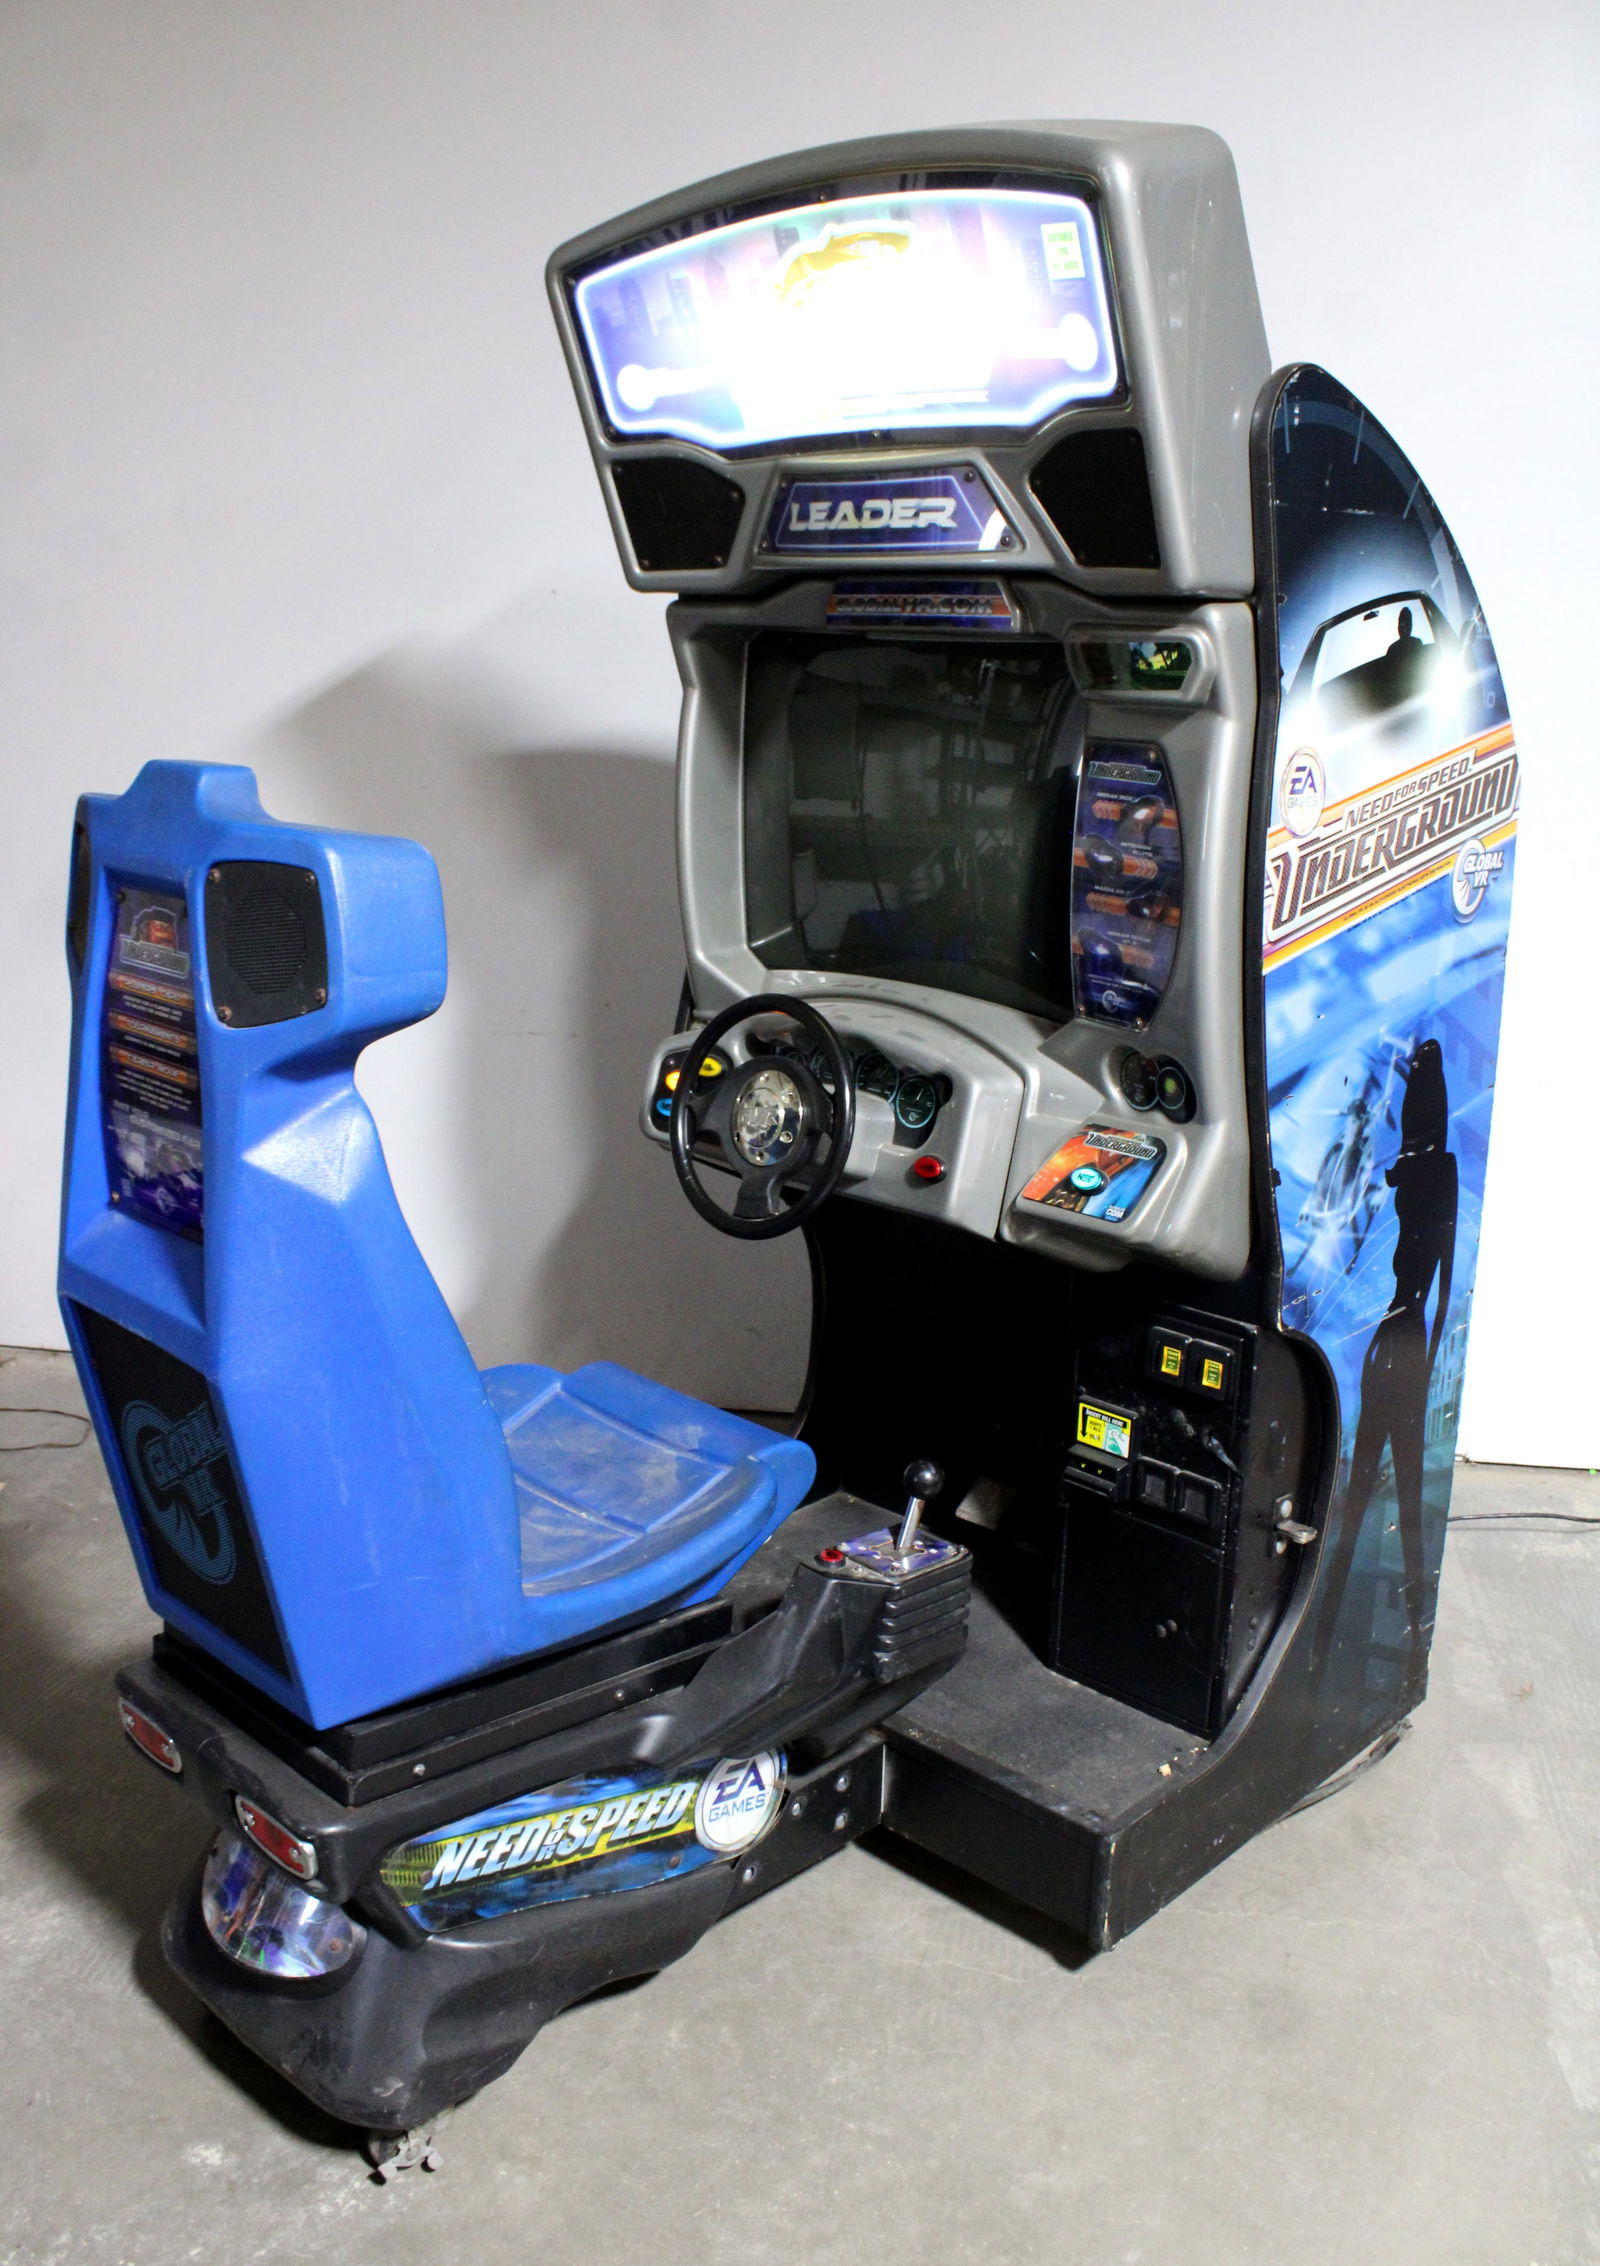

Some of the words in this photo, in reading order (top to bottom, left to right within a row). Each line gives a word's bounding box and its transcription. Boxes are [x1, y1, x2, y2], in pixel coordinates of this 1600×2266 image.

[789, 497, 958, 532] LEADER
[1289, 765, 1318, 795] EA
[1344, 790, 1394, 832] NEED
[1394, 780, 1418, 802] FOR
[1270, 753, 1519, 932] UNDERGROUND
[1464, 851, 1504, 874] GLOBAL
[1473, 870, 1489, 889] VR
[714, 1758, 766, 1805] EA
[707, 1796, 767, 1824] GAMES
[423, 1819, 551, 1892] NEED
[536, 1812, 574, 1861] FOR
[556, 1781, 699, 1853] SPEED
